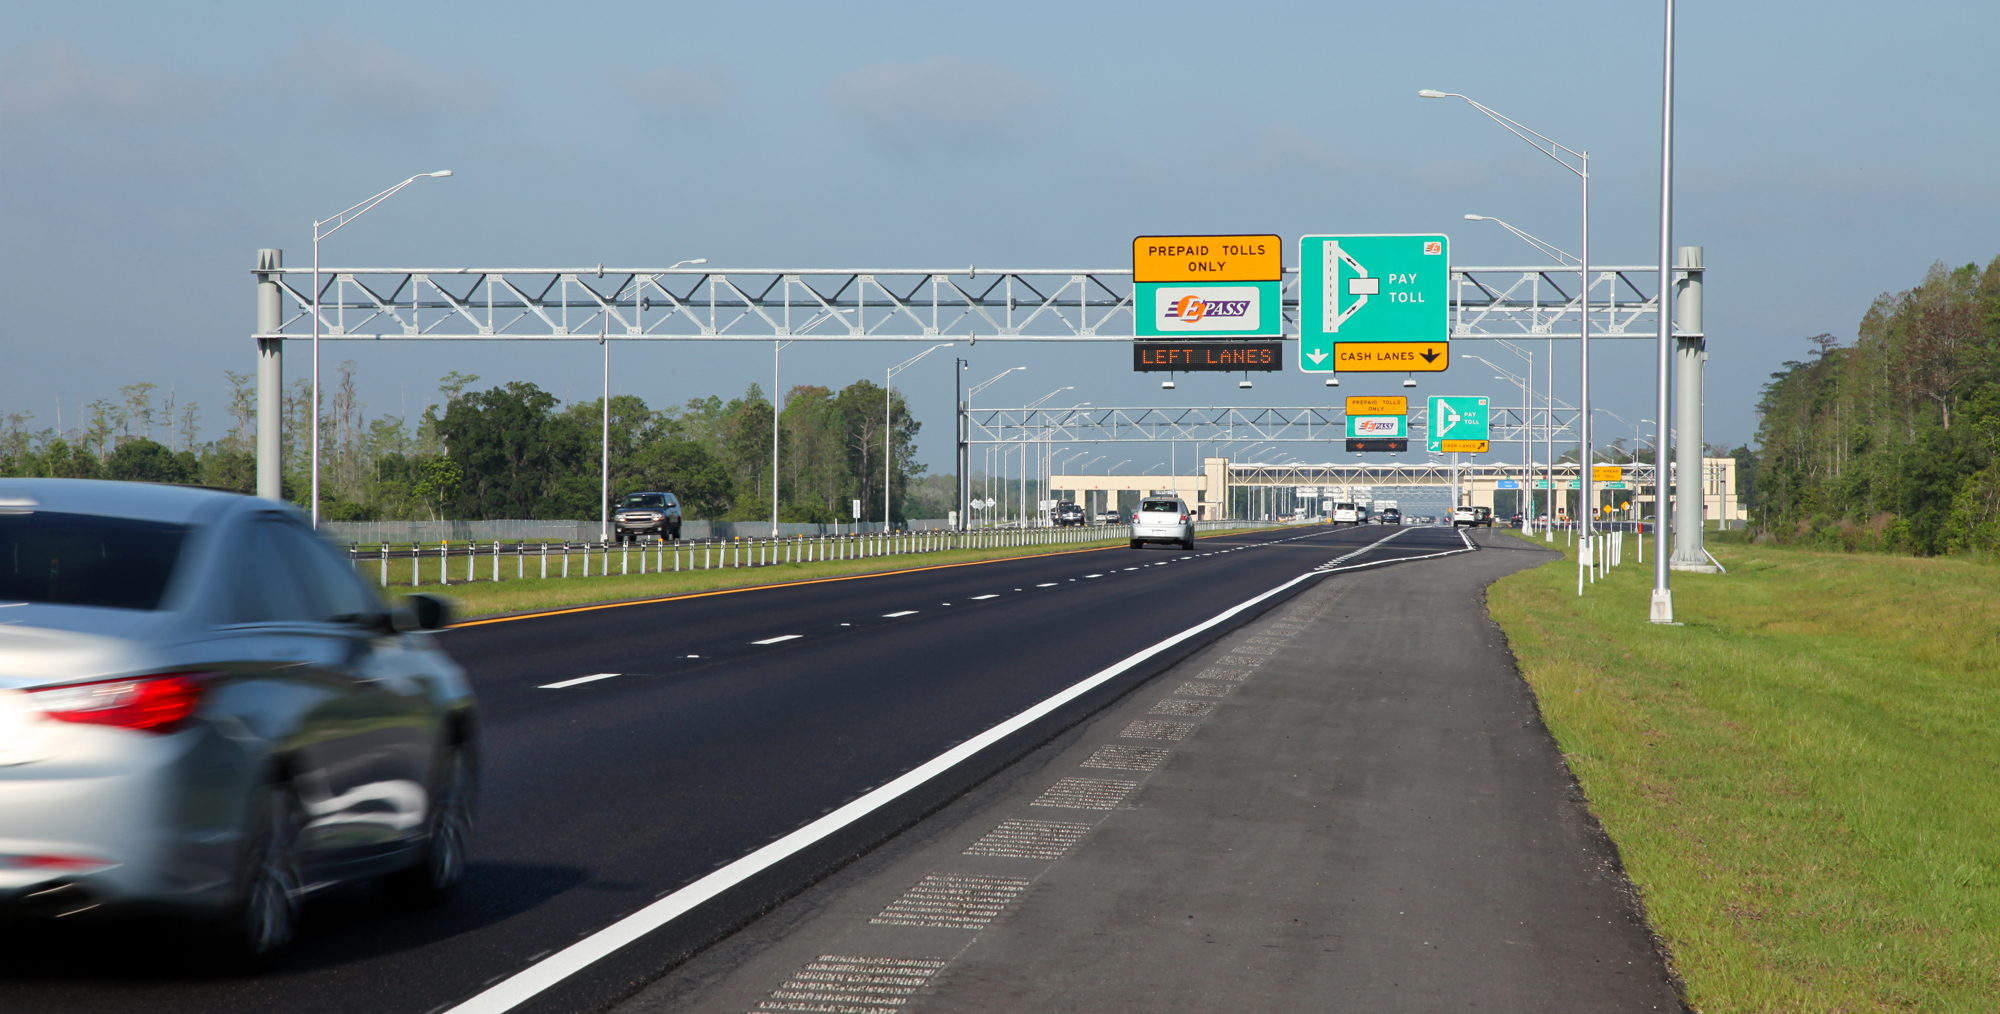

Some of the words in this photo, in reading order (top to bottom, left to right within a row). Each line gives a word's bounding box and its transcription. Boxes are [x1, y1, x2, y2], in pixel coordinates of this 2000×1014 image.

[1149, 246, 1209, 256] PREPAID
[1222, 245, 1266, 255] TOLLS
[1188, 262, 1226, 271] ONLY
[1389, 273, 1417, 284] PAY
[1389, 292, 1425, 303] TOLL
[1142, 349, 1193, 364] LEFT
[1207, 349, 1272, 364] LANES
[1340, 352, 1371, 361] CASH
[1377, 352, 1414, 361] LANES
